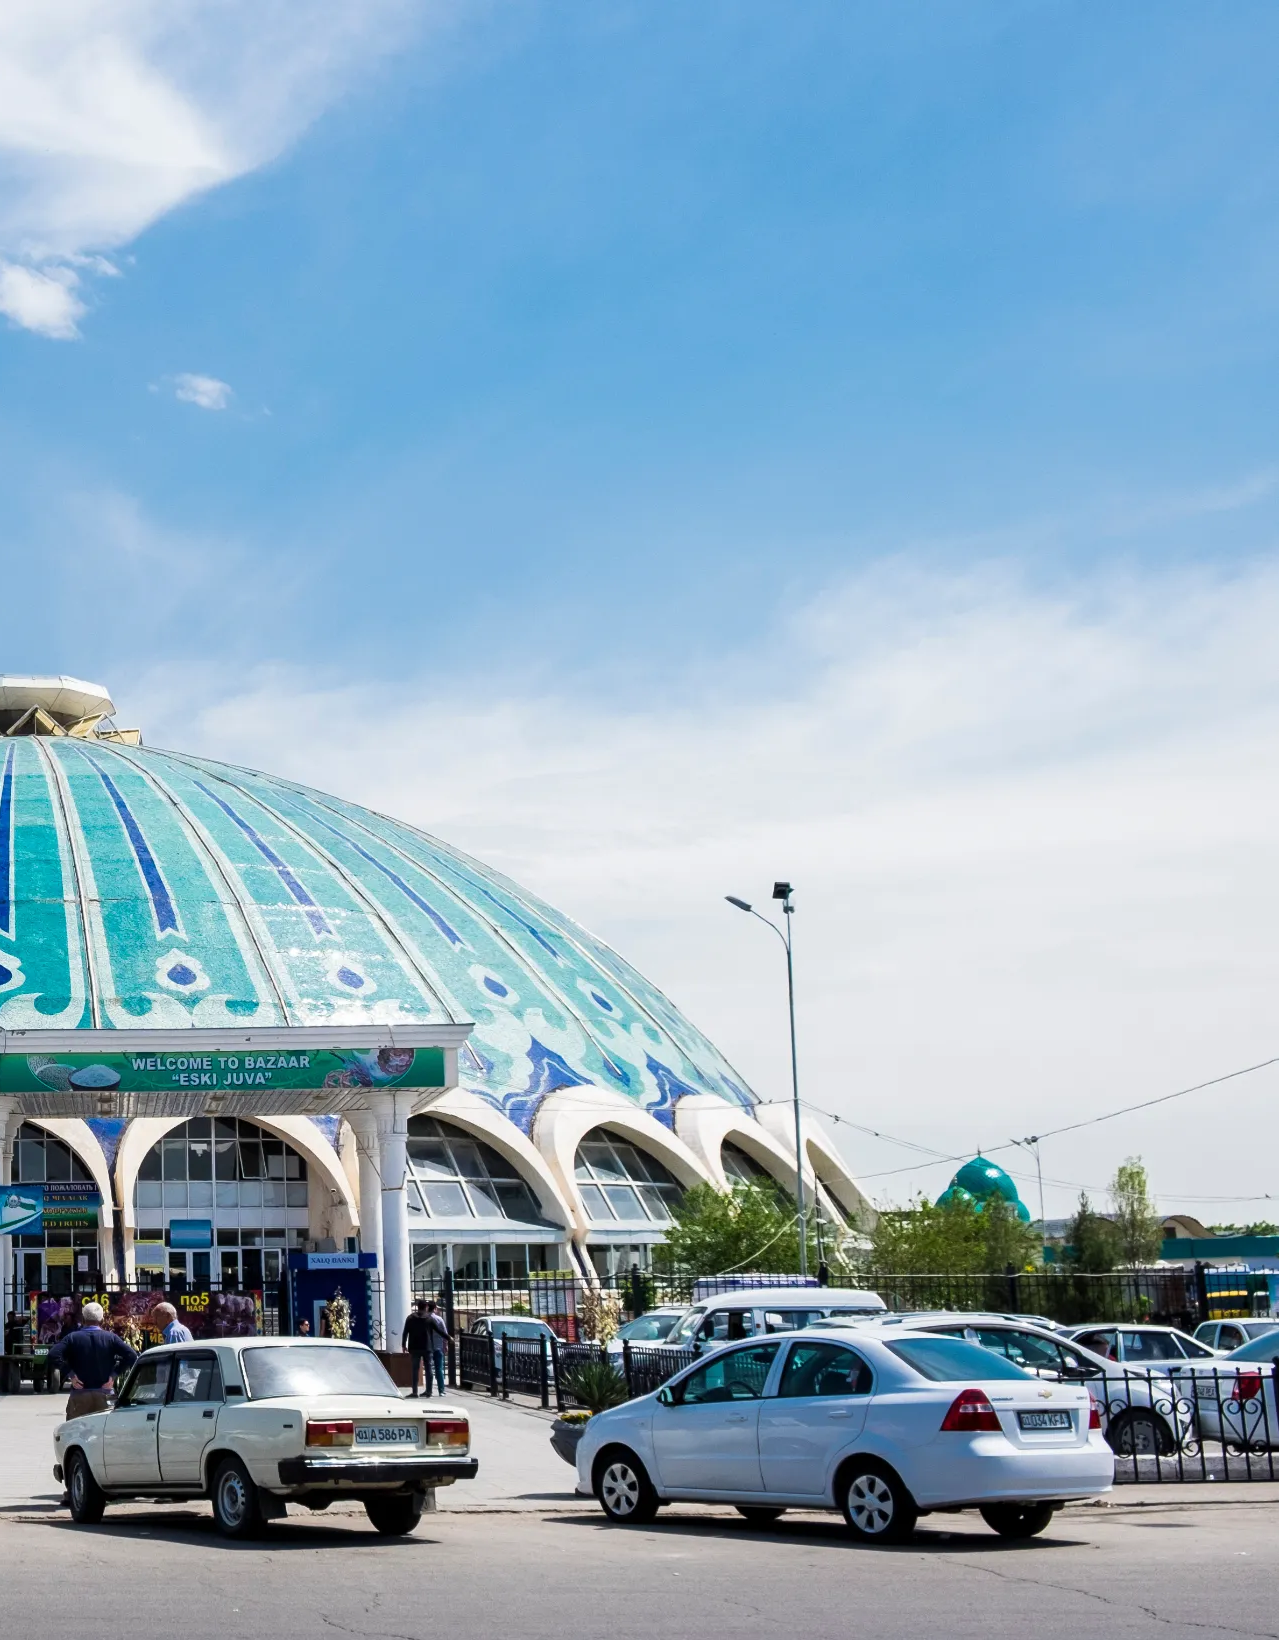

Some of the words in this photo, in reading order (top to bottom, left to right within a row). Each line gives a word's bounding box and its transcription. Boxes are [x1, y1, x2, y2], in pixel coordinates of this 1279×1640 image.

[131, 1057, 213, 1070] WELCOME
[217, 1056, 238, 1070] TO
[244, 1055, 310, 1069] BAZAAR
[172, 1073, 217, 1086] “ESKI
[223, 1072, 272, 1085] JUVA”
